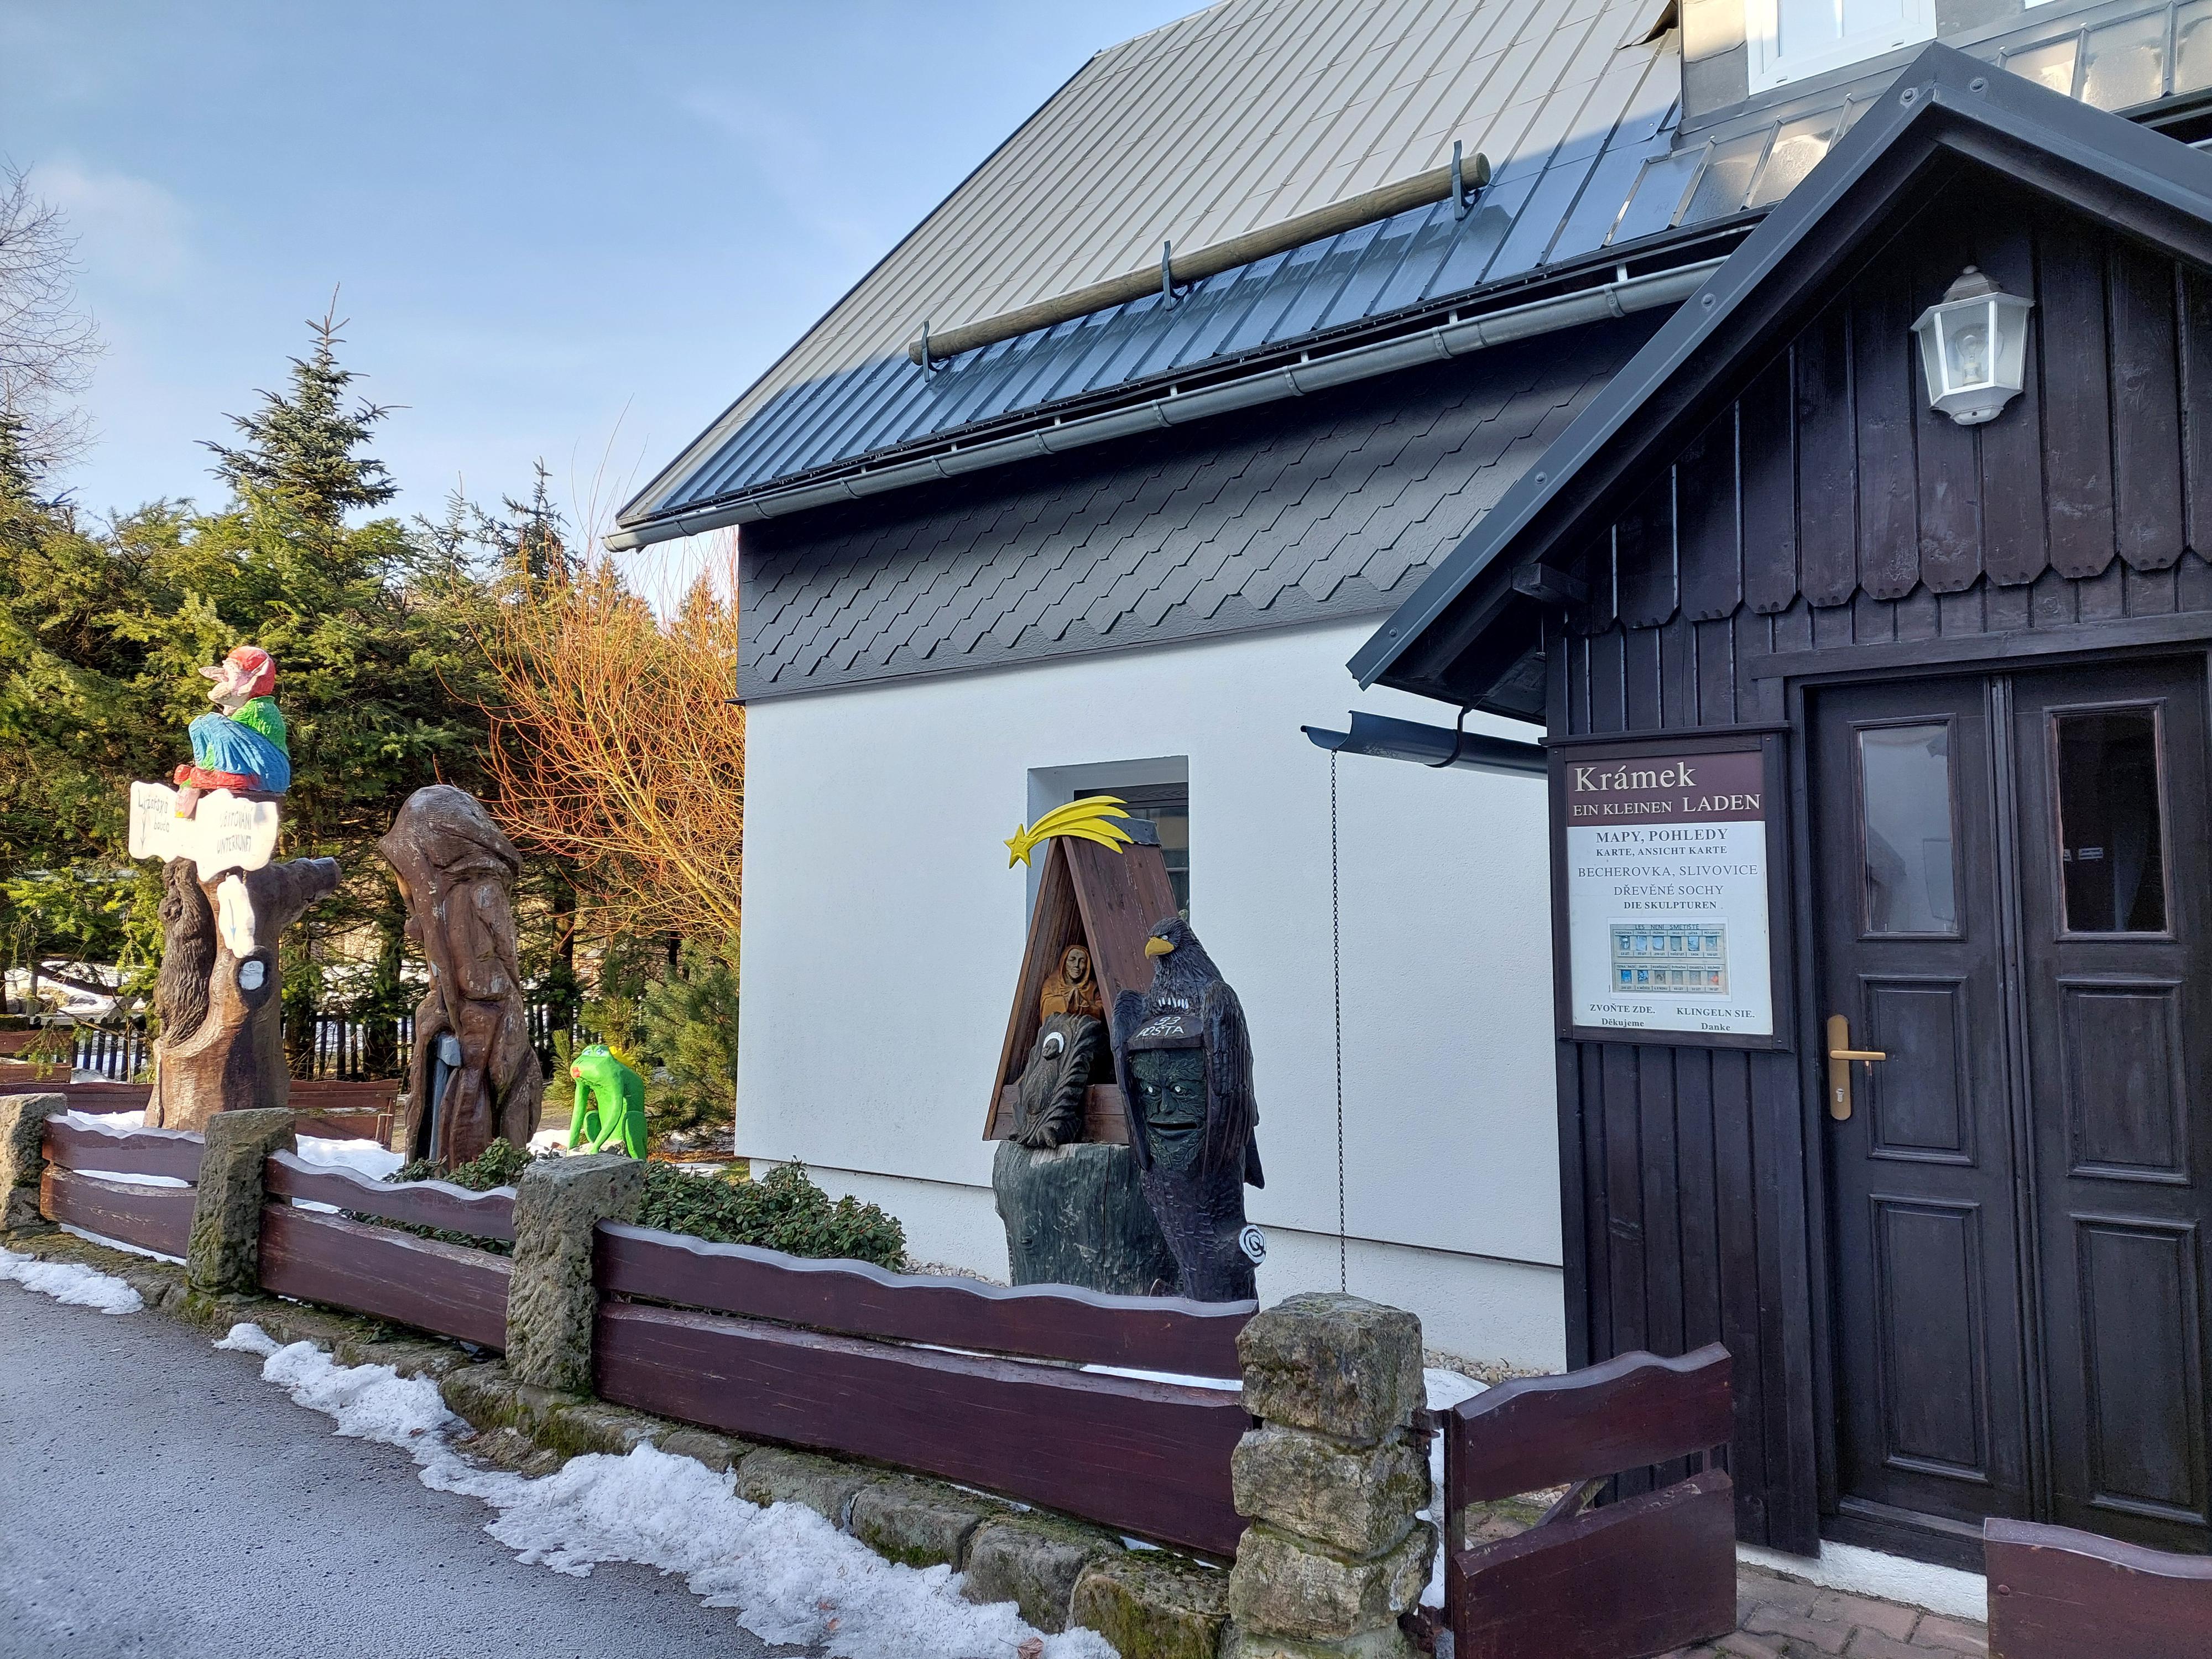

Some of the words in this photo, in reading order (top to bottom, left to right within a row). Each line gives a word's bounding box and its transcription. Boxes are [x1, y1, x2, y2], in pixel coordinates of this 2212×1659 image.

[1574, 761, 1697, 792] Krámek
[1573, 804, 1599, 816] EIN
[1603, 801, 1672, 815] KLEINEN
[1683, 794, 1761, 812] LADEN
[1596, 832, 1645, 844] MAPY,
[1649, 828, 1728, 842] POHLEDY
[1596, 848, 1635, 857] KARTE,
[1637, 847, 1686, 855] ANSICHT
[1689, 846, 1727, 854] KARTE
[1578, 866, 1675, 878] BECHEROVKA,
[1679, 865, 1758, 876] SLIVOVICE
[1614, 883, 1674, 896] DŘEVĚNÉ
[1678, 885, 1724, 895] SOCHY
[1644, 901, 1717, 909] SKULPTUREN
[1590, 1003, 1630, 1013] ZVOŇTE
[1677, 1008, 1732, 1017] KLINGELN
[1601, 1018, 1645, 1027] Děkujeme
[1701, 1022, 1731, 1031] Danke
[1136, 1024, 1185, 1038] POŠTA
